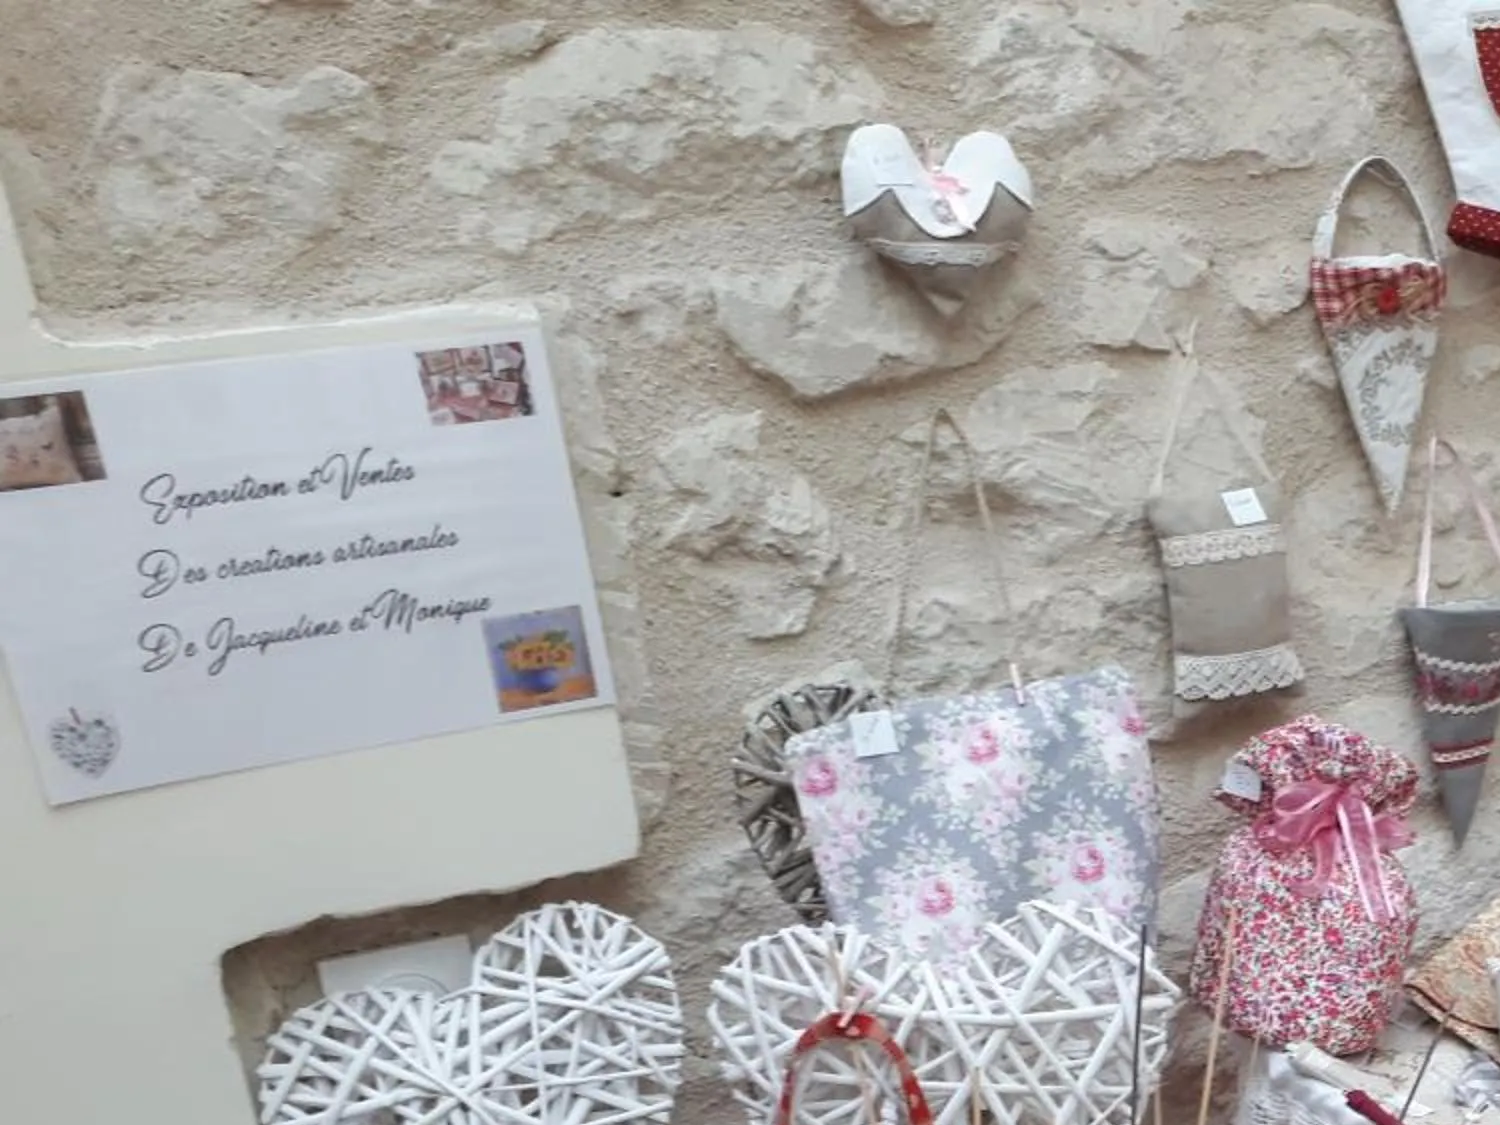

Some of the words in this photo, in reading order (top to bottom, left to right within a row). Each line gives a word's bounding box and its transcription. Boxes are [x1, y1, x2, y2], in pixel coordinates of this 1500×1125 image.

[139, 474, 289, 524] Exposition
[298, 466, 321, 493] et
[319, 447, 415, 500] Ventes
[137, 549, 207, 598] Des
[332, 525, 459, 563] artisanales
[137, 623, 196, 672] De
[206, 615, 342, 676] Jacqueline
[349, 606, 374, 631] et
[371, 588, 492, 633] Monique
